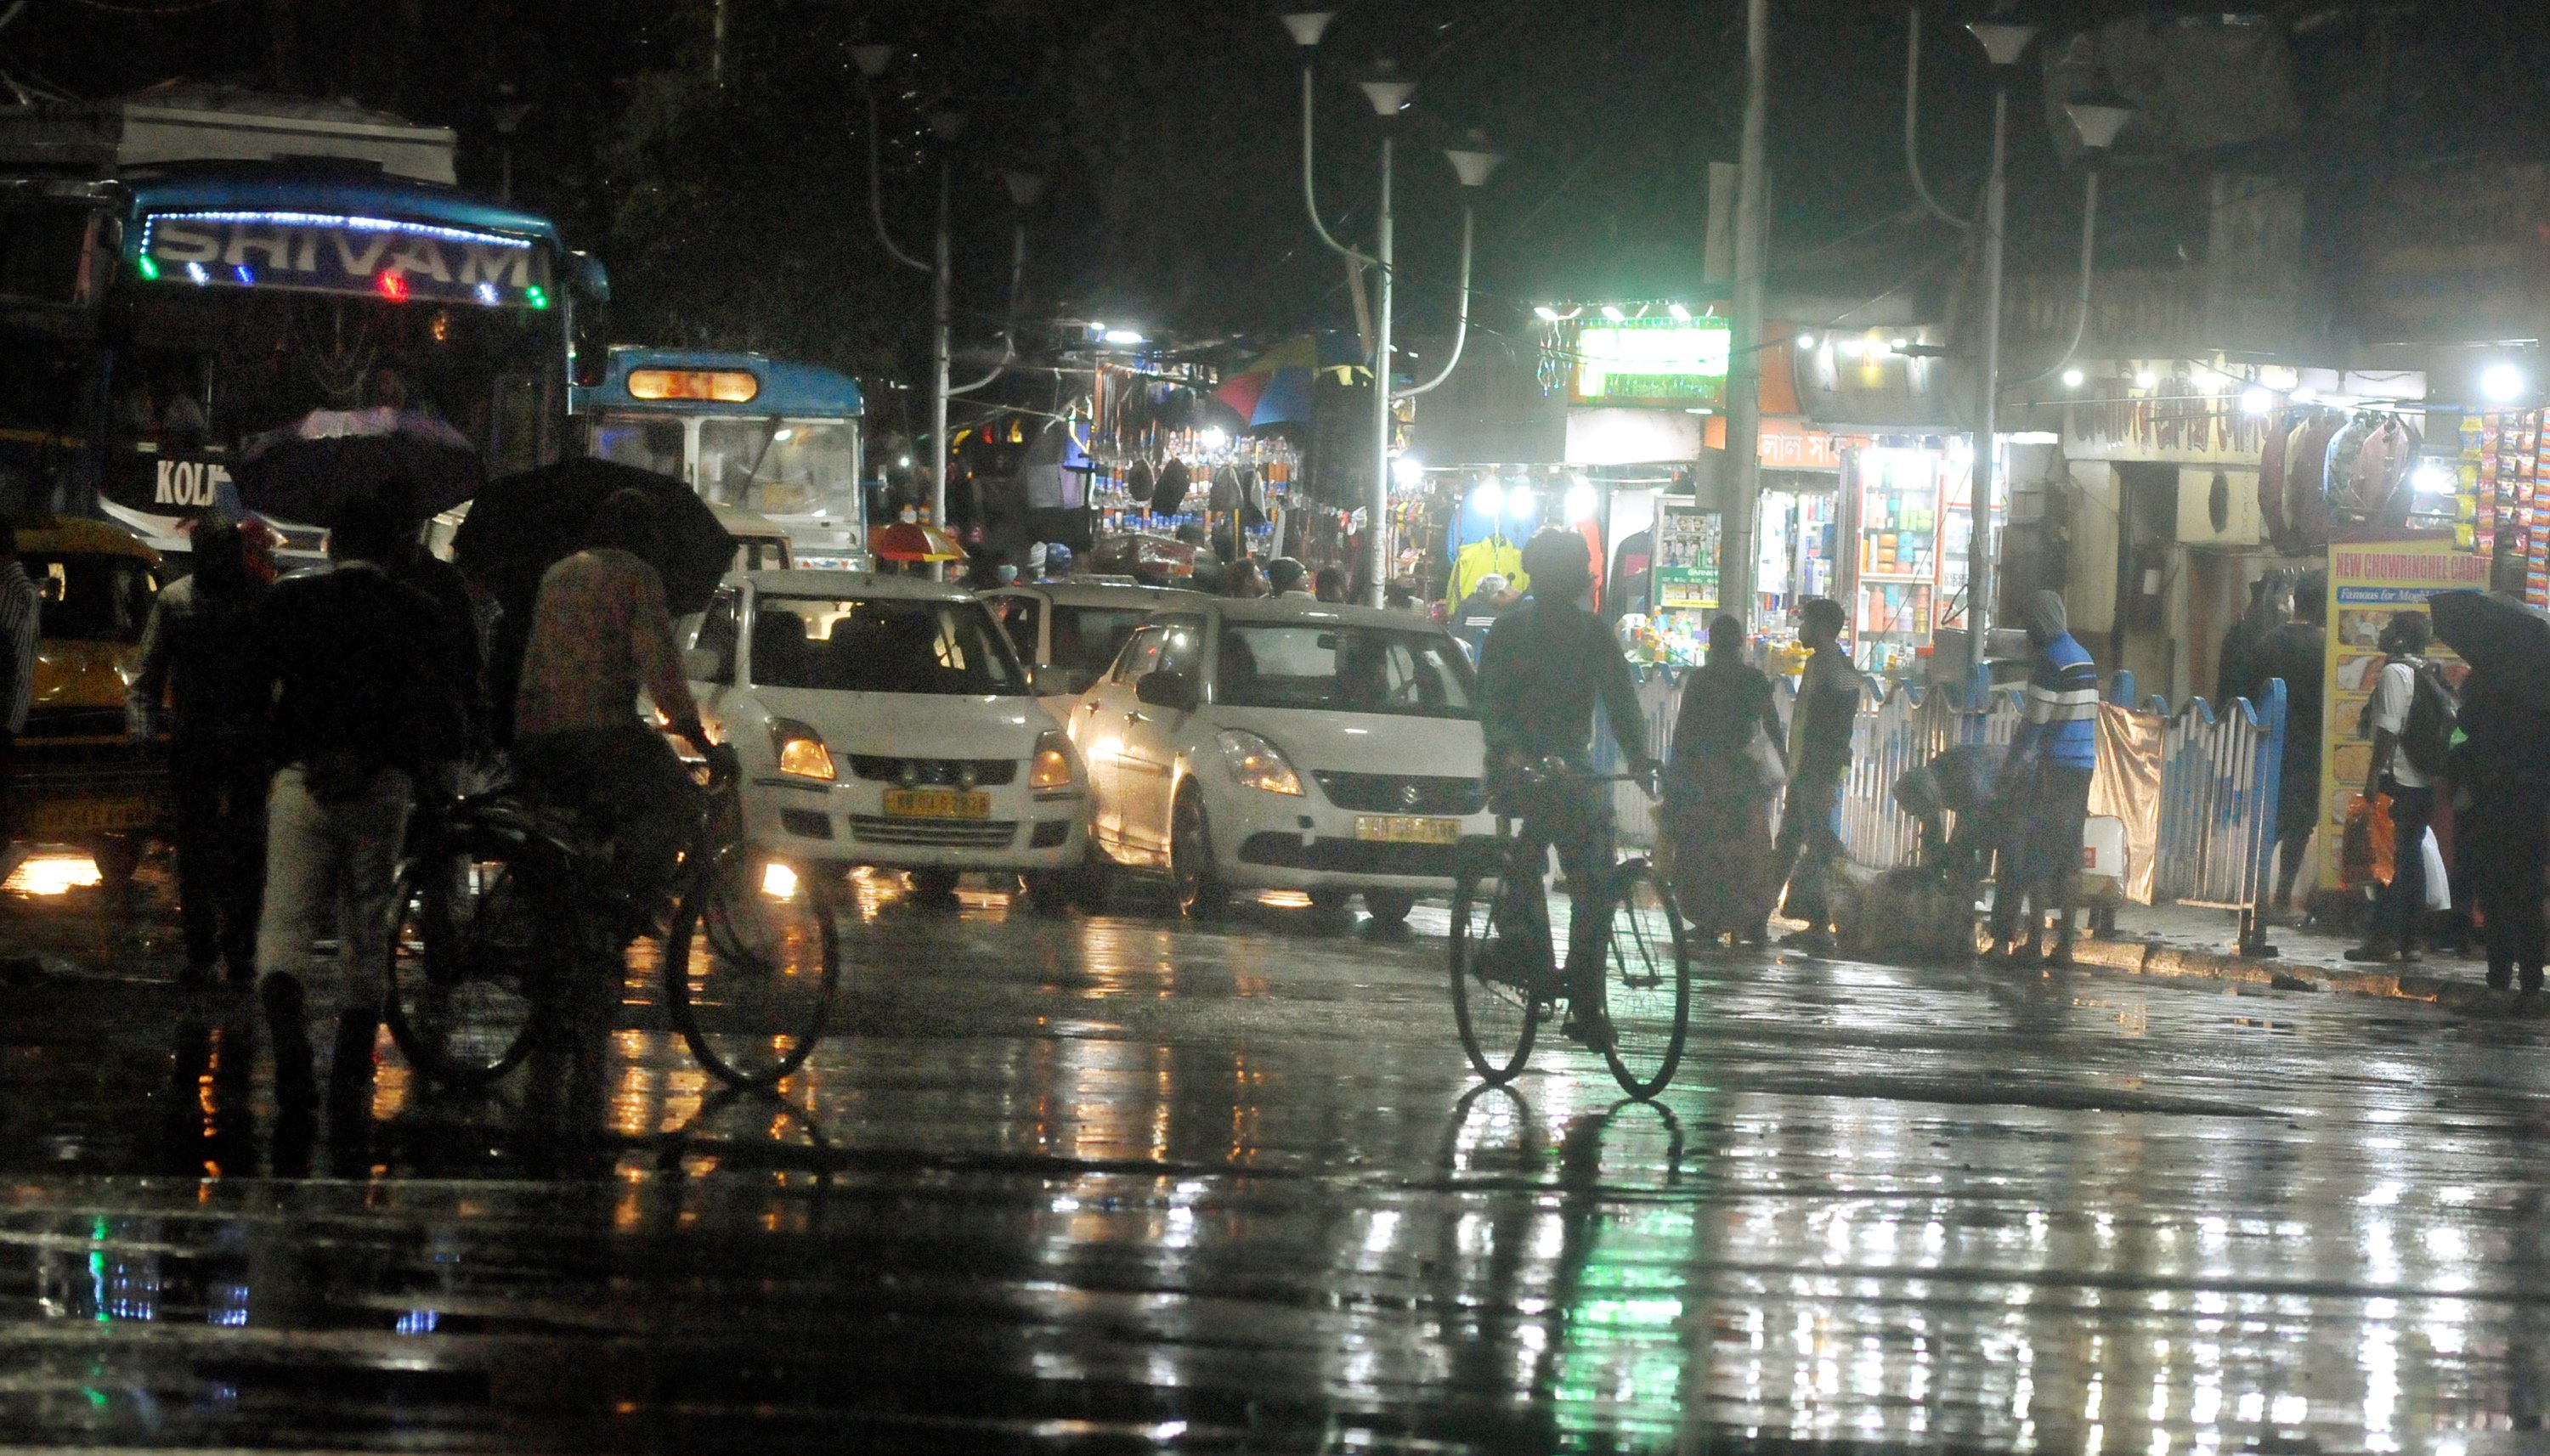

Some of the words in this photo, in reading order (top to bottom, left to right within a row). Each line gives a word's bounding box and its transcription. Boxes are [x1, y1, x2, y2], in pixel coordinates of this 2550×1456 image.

[155, 221, 530, 287] SHIVAM
[2337, 552, 2361, 578] NEW
[2340, 587, 2379, 601] Famous
[2379, 587, 2395, 601] for
